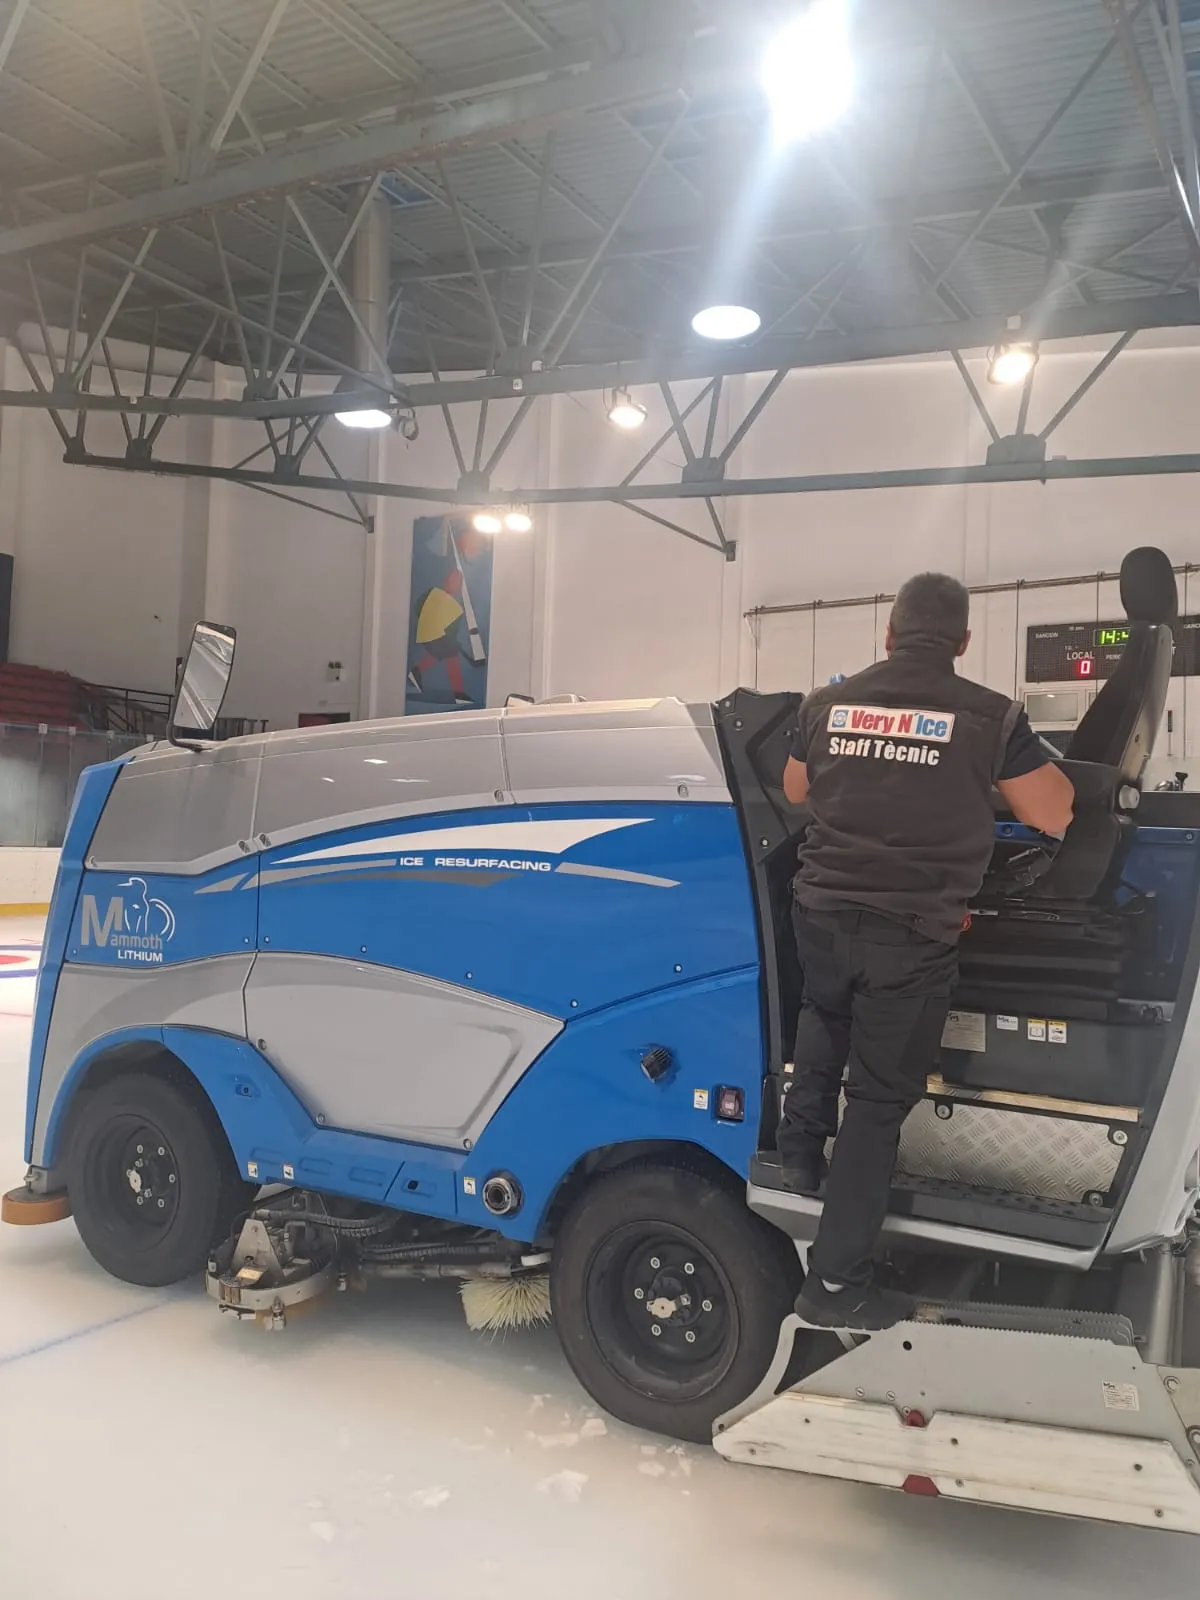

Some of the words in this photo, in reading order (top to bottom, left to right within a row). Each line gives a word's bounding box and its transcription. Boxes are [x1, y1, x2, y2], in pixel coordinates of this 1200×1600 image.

[1066, 651, 1095, 660] LOCAL
[1080, 660, 1091, 674] 0
[851, 709, 895, 734] Very
[829, 737, 871, 757] Staff
[874, 740, 940, 766] Tècnic
[400, 857, 424, 866] ICE
[434, 857, 552, 871] RESURFACING
[80, 894, 163, 949] Mammoth
[117, 949, 163, 962] LITHIUM
